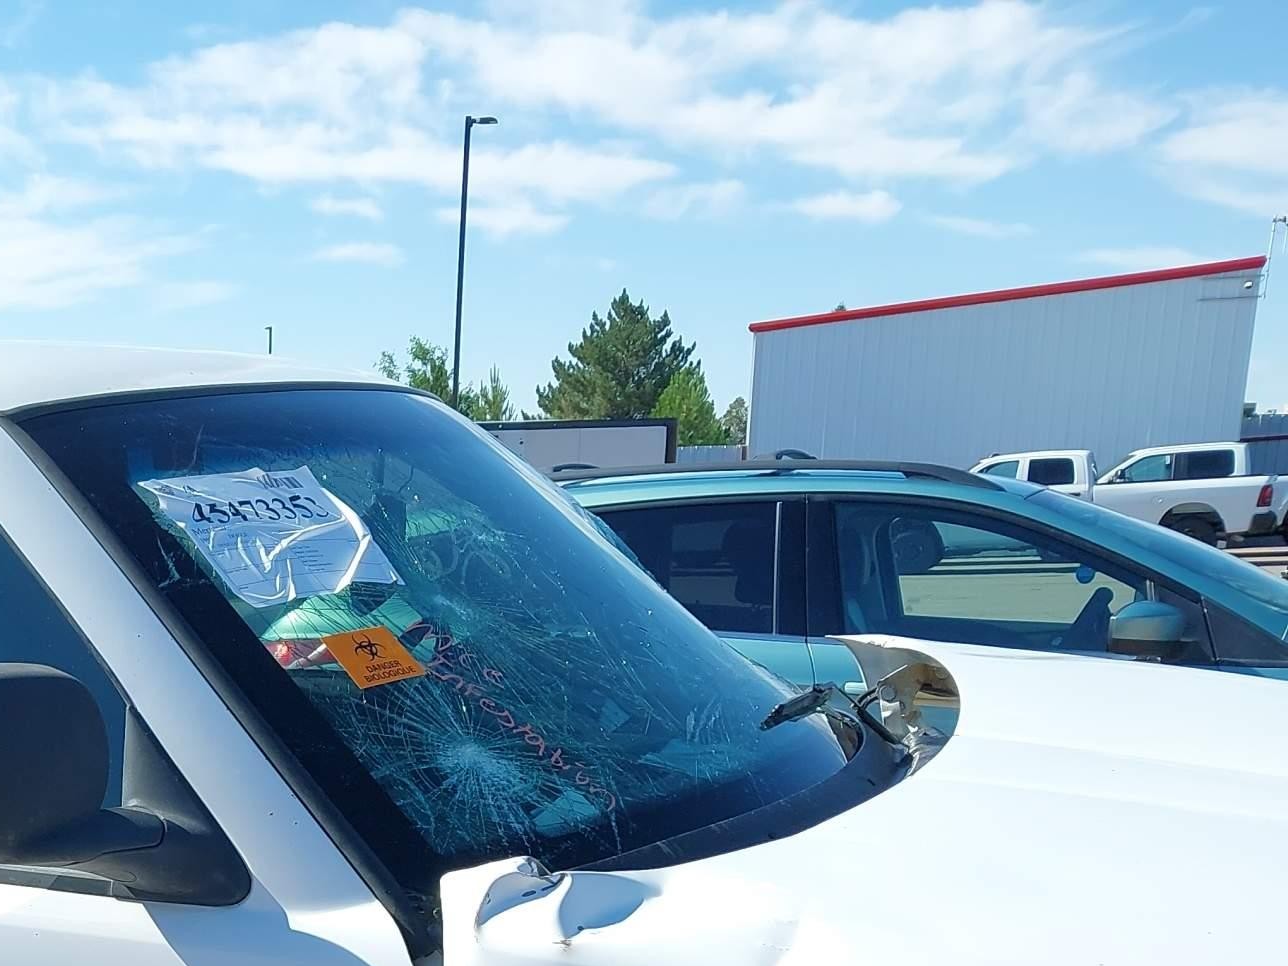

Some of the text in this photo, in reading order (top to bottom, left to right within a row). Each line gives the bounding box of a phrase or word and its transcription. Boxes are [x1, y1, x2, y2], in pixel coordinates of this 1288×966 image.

[192, 494, 329, 524] 45473353
[363, 665, 417, 682] BIOLOGIQUE
[366, 660, 402, 673] DANGER
